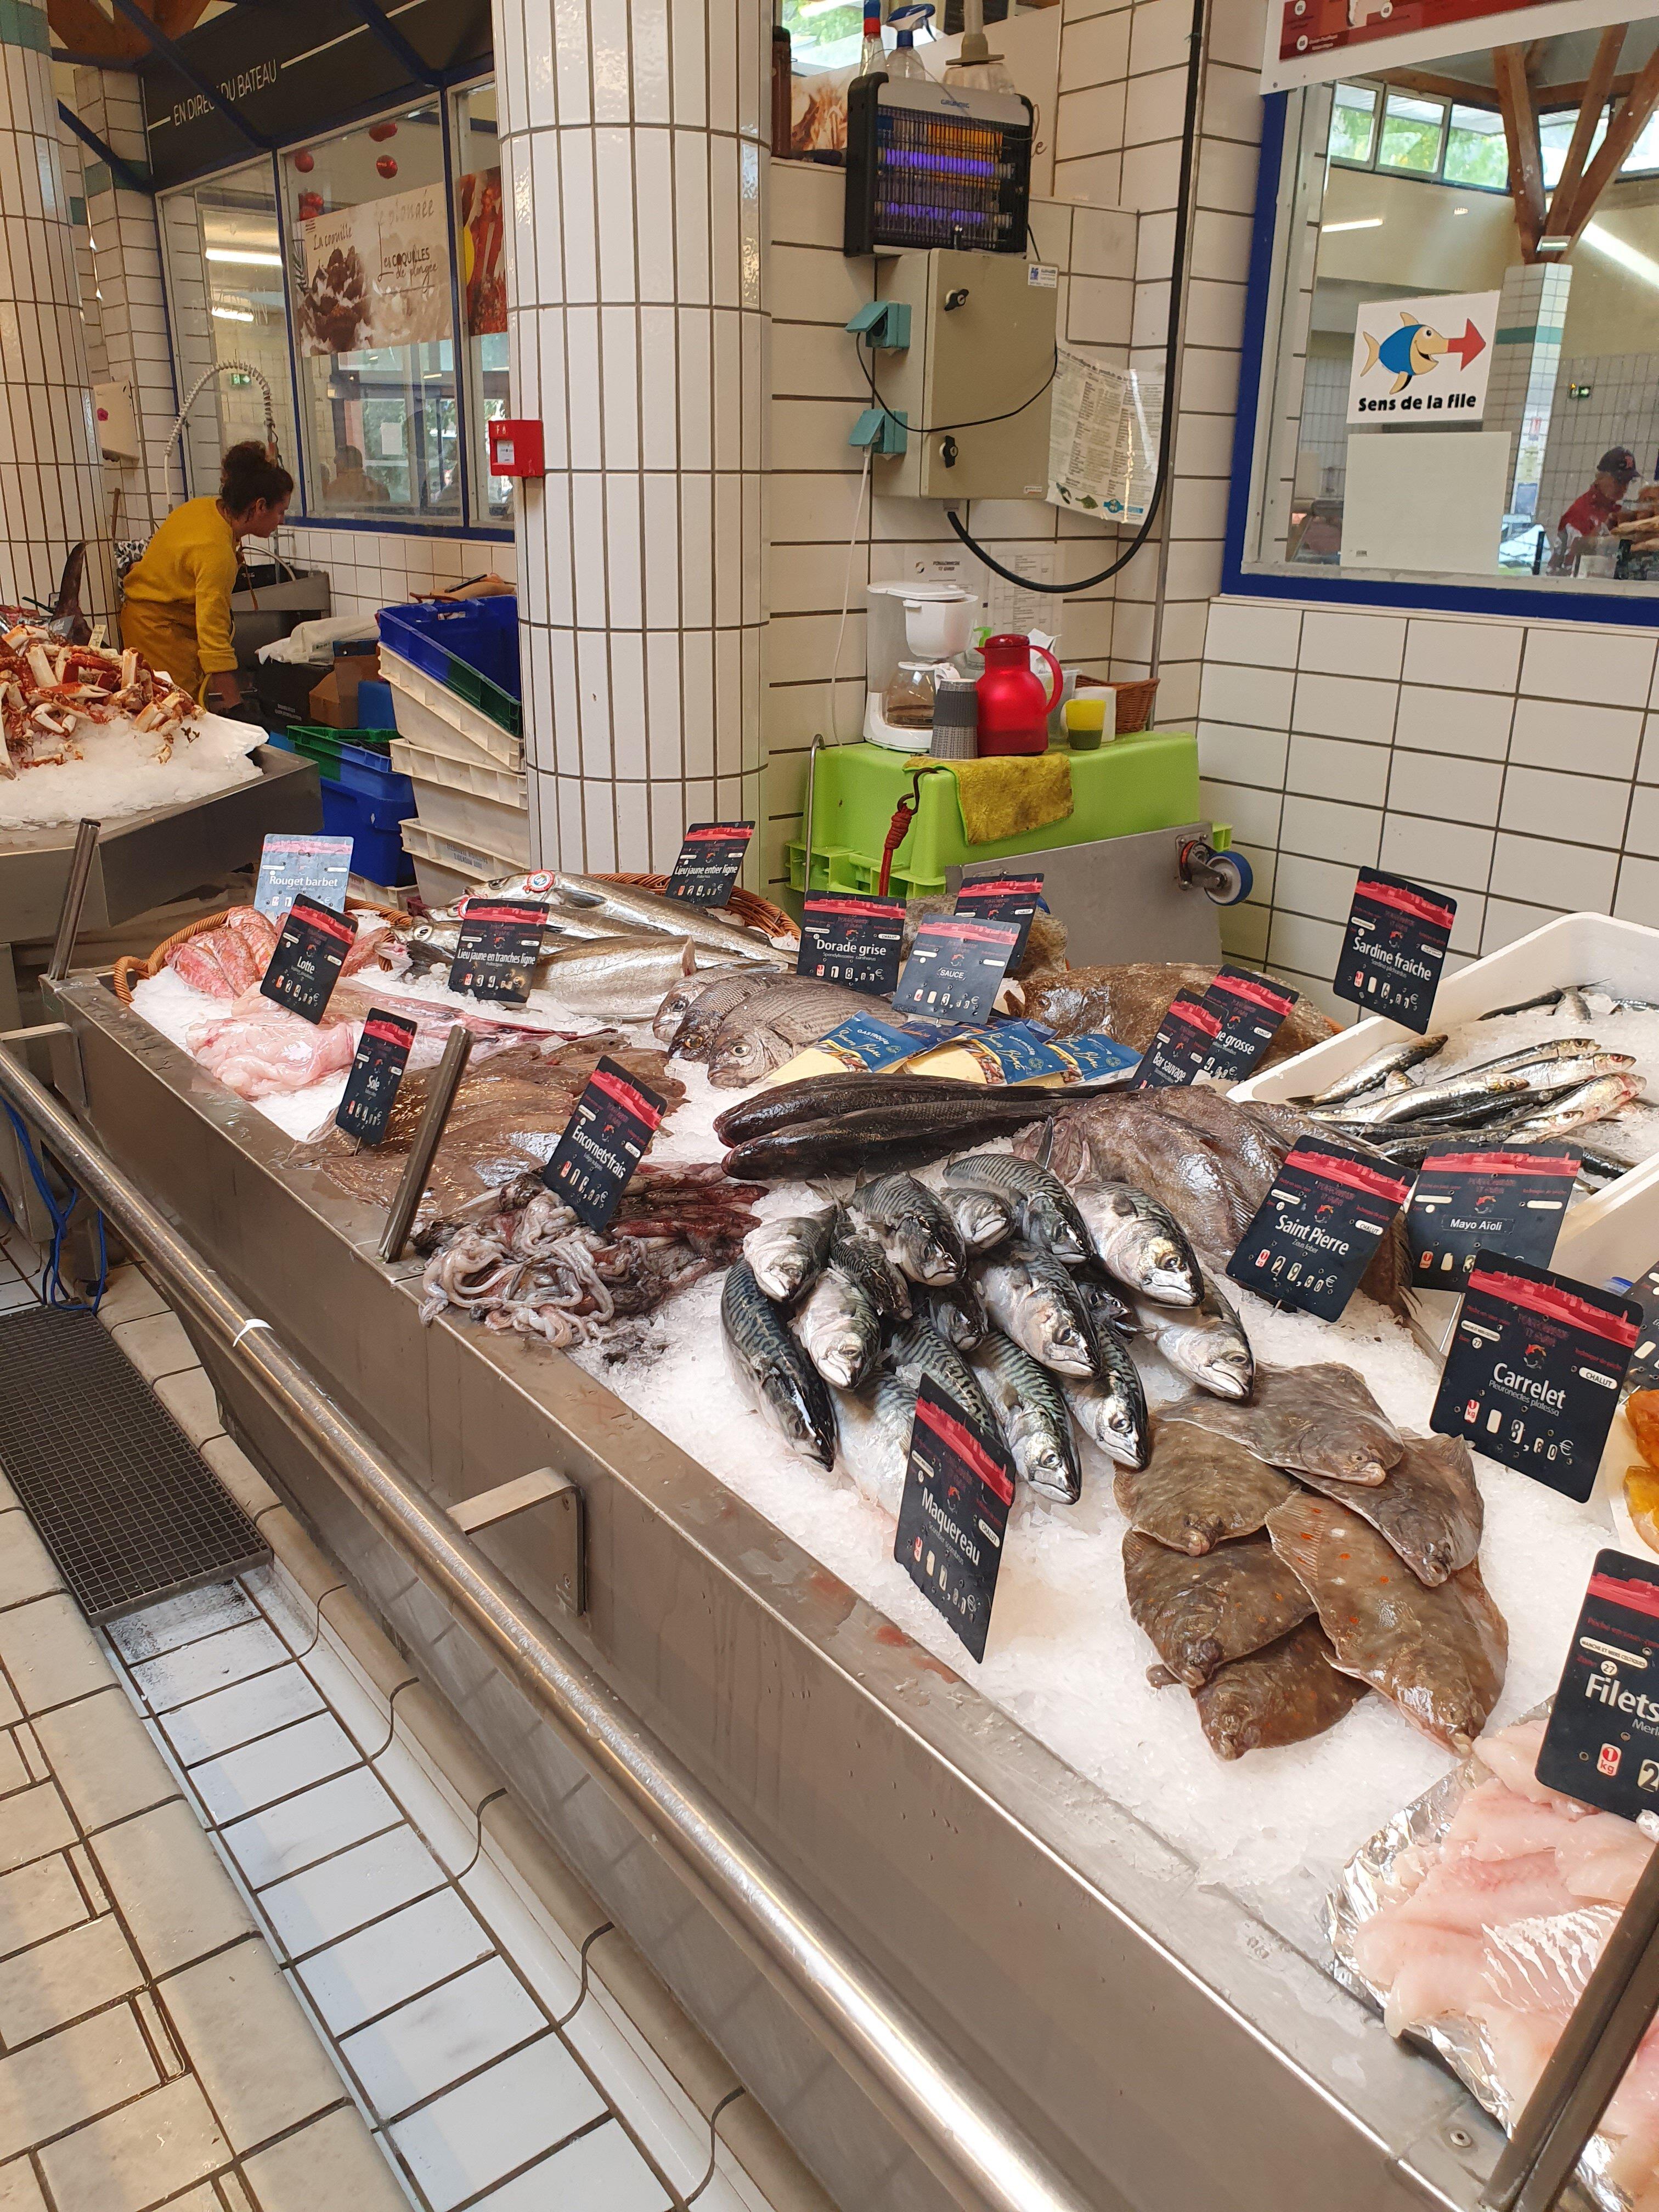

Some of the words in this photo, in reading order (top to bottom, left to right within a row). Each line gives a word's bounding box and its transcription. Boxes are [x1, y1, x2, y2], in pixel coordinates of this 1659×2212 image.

[173, 102, 186, 126] EN
[238, 59, 277, 98] BATEAU
[1358, 397, 1396, 411] Sens
[1401, 396, 1423, 410] de
[1426, 394, 1443, 409] la
[1447, 393, 1477, 409] file
[674, 865, 688, 875] Lieu
[686, 865, 704, 877] jaune
[704, 864, 723, 874] entier
[721, 864, 738, 876] ligne
[269, 876, 304, 888] Rouget
[305, 876, 338, 887] barbet
[816, 939, 857, 953] Dorade
[859, 944, 887, 956] grise
[297, 956, 315, 974] Lotte
[458, 948, 470, 959] Lieu
[469, 949, 486, 962] jaune
[495, 952, 521, 964] tranches
[521, 953, 536, 967] ligne
[1352, 936, 1393, 964] Sardine
[1395, 952, 1432, 981] fraîche
[940, 969, 964, 979] SAUCE
[1223, 1035, 1255, 1055] grosse
[1152, 1051, 1165, 1067] Bar
[1161, 1060, 1186, 1084] sauvage
[366, 1075, 380, 1091] Sole
[572, 1125, 608, 1164] Encornets
[606, 1153, 627, 1180] frais
[1359, 1223, 1379, 1235] CHALUT
[1450, 1218, 1477, 1231] Mayo
[1275, 1214, 1311, 1240] Saint
[1308, 1227, 1350, 1255] Pierre
[1474, 1339, 1481, 1347] 27
[1493, 1363, 1566, 1410] Carrelet
[1585, 1372, 1613, 1387] CHALUT
[1488, 1379, 1530, 1403] Pleuronectes
[1530, 1399, 1560, 1417] platessa
[1467, 1409, 1476, 1419] kg
[921, 1486, 980, 1566] Maquereau
[981, 1523, 997, 1543] CHALUT
[1602, 1663, 1615, 1674] 27
[1584, 1673, 1659, 1723] Filets
[1600, 1759, 1615, 1774] kg
